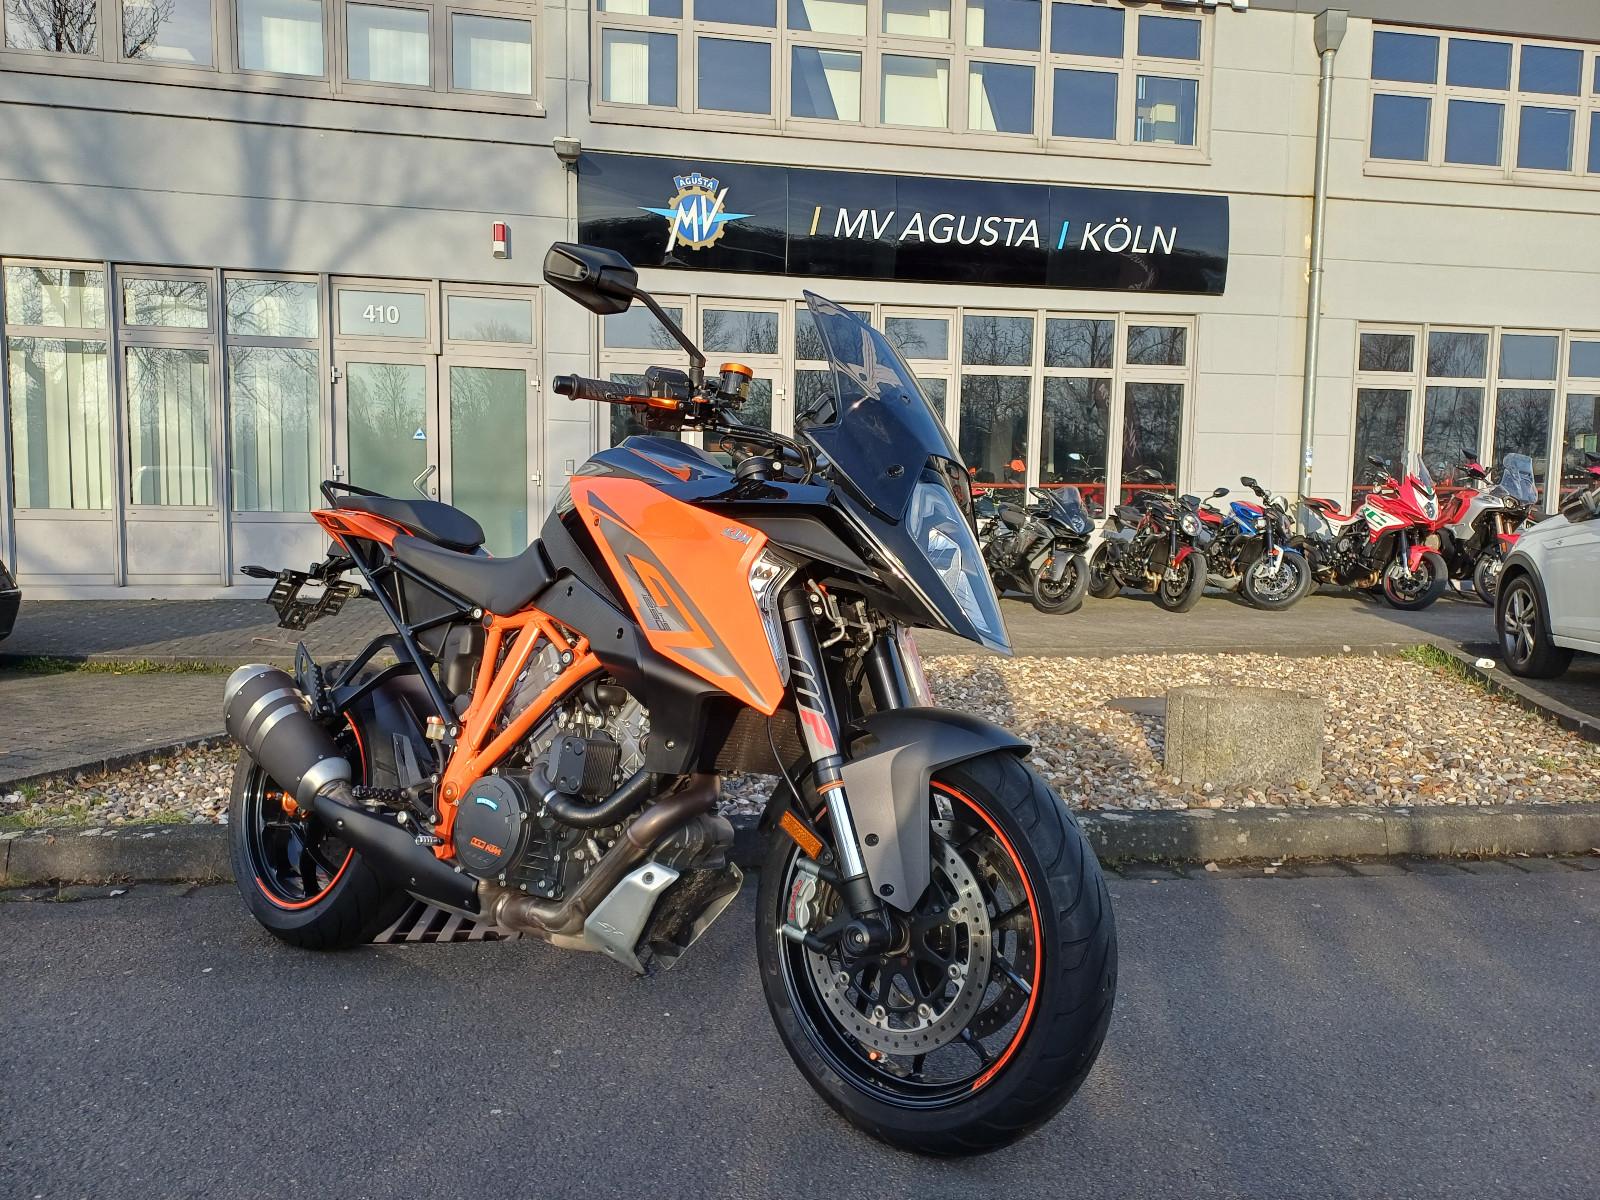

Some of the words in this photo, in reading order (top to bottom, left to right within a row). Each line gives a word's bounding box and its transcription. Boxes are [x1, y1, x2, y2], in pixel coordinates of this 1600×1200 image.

[679, 176, 714, 189] AGUSTA
[664, 186, 730, 253] MV
[833, 207, 896, 240] MV
[898, 211, 1041, 249] AGUSTA
[1079, 216, 1178, 256] KÖLN
[362, 303, 400, 325] 410
